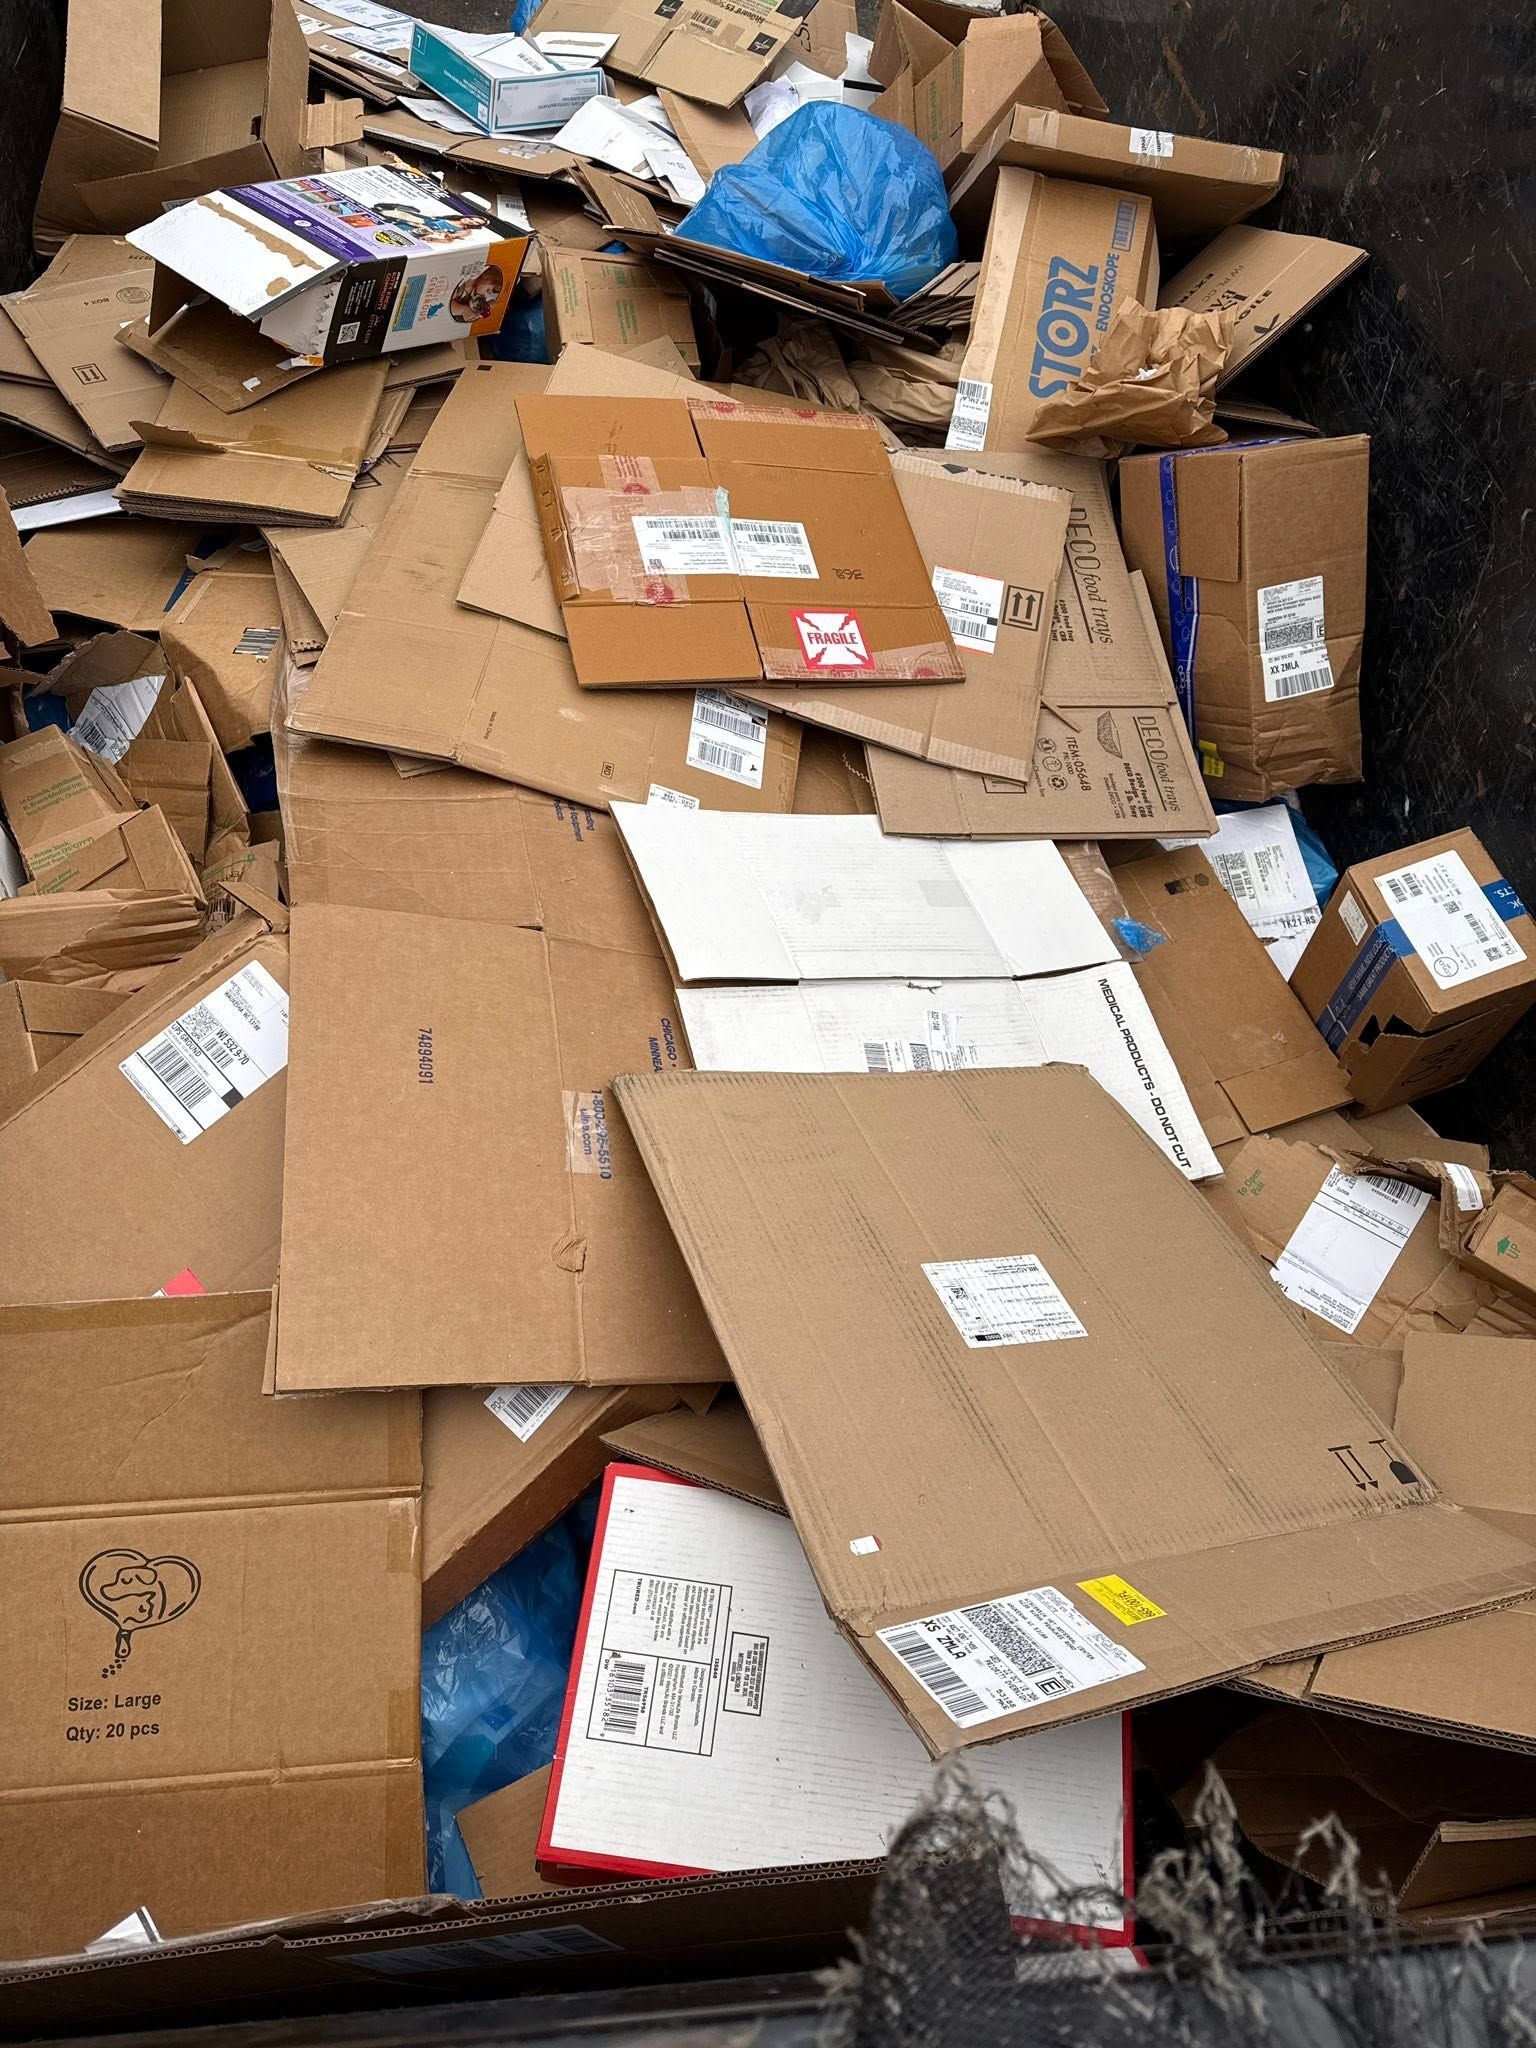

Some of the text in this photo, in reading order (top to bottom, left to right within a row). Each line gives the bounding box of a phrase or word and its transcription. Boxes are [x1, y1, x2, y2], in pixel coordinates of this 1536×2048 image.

[1095, 252, 1119, 331] ENDOSKOPE
[1028, 256, 1099, 397] STORZ
[1075, 570, 1106, 601] food
[1091, 608, 1113, 643] trays
[807, 631, 859, 645] FRAGILE
[1269, 660, 1299, 674] XX ZMLA
[604, 764, 611, 774] MD
[1065, 736, 1091, 791] ITEM:05648
[1136, 716, 1180, 811] DECO food trays
[1123, 763, 1133, 776] DECO
[1128, 779, 1139, 797] Design
[1129, 805, 1137, 817] Tray
[1140, 789, 1149, 803] Food
[1146, 804, 1154, 817] Tray
[1281, 915, 1315, 928] TK21-HS
[171, 1023, 202, 1057] UPS GROUND
[216, 1028, 249, 1065] WI 532 9-70
[661, 1018, 676, 1060] CHICAGO
[419, 1028, 432, 1083] 74894091
[1097, 978, 1126, 1028] MEDICAL
[1120, 1028, 1154, 1090] PRODUCTS
[1150, 1097, 1166, 1116] DO
[1158, 1116, 1178, 1142] NOT
[1171, 1144, 1191, 1168] CUT
[1236, 1167, 1263, 1197] To Open
[1250, 1180, 1266, 1196] Pull
[1506, 1243, 1521, 1257] UP
[919, 1620, 967, 1660] XS ZMLA
[1039, 1678, 1062, 1694] E
[1054, 1670, 1076, 1688] FedEx
[67, 1691, 162, 1713] Size: Large
[65, 1722, 160, 1743] Qty: 20 pcs
